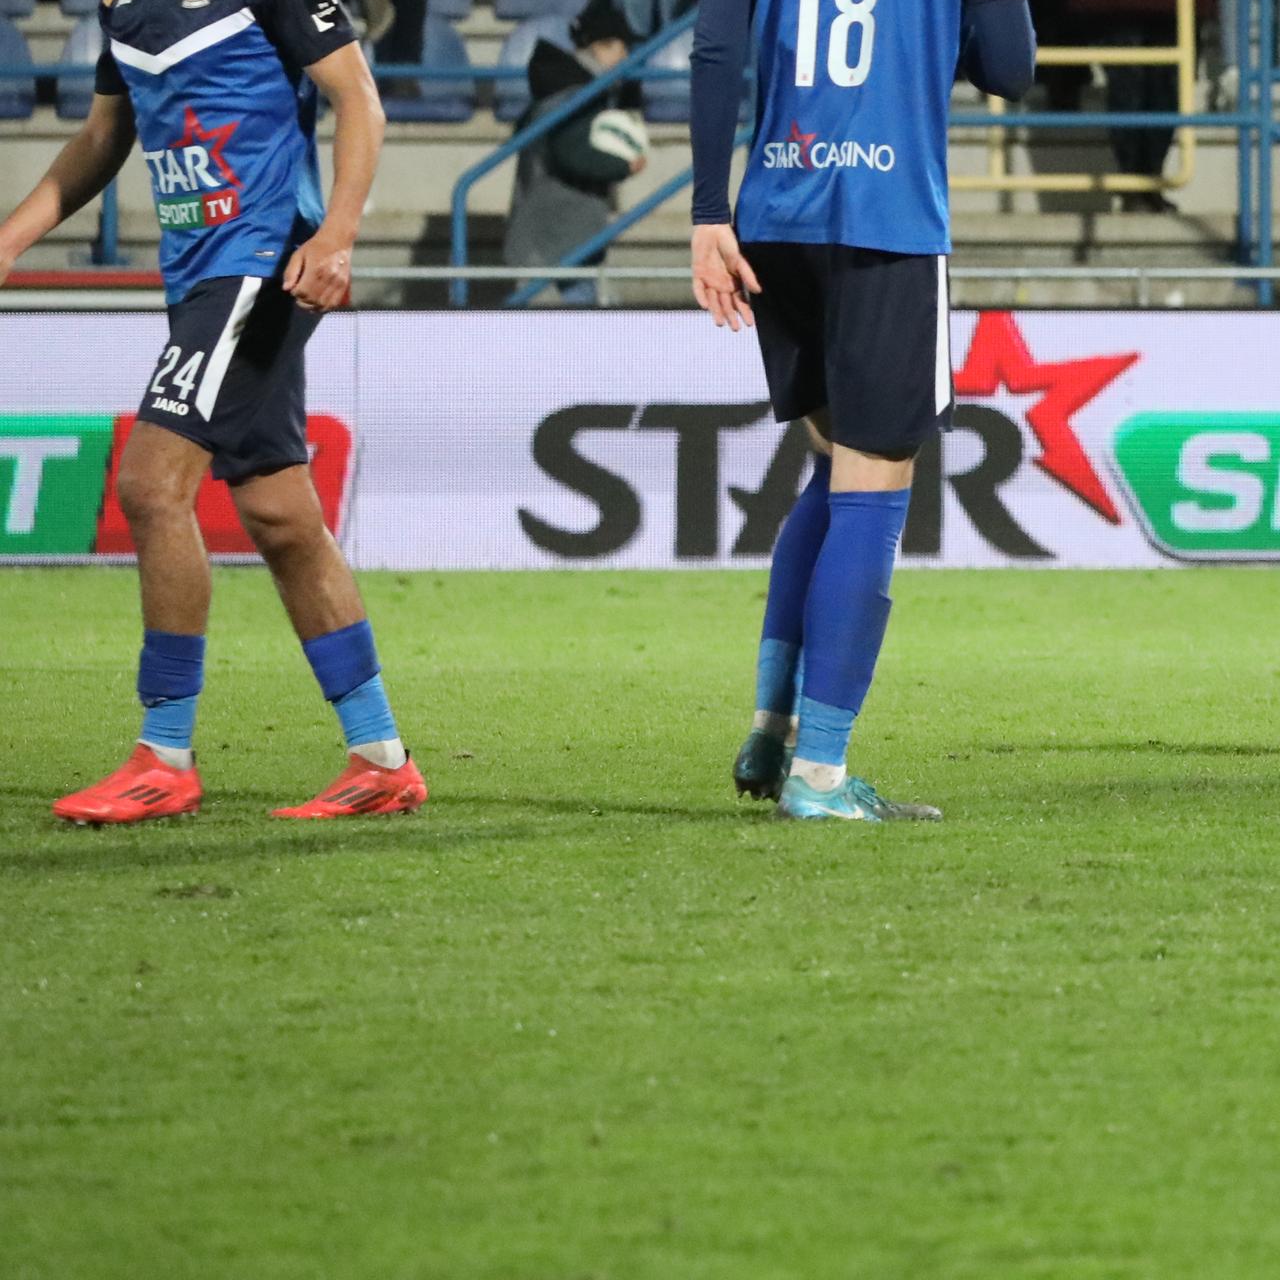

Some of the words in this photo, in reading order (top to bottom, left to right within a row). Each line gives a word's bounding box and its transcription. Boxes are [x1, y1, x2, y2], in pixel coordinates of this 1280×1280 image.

[144, 145, 222, 194] TAR
[810, 141, 895, 172] CASINO
[159, 201, 200, 224] SPORT
[207, 197, 233, 218] TV
[150, 345, 205, 400] 24
[152, 397, 190, 416] JAKO
